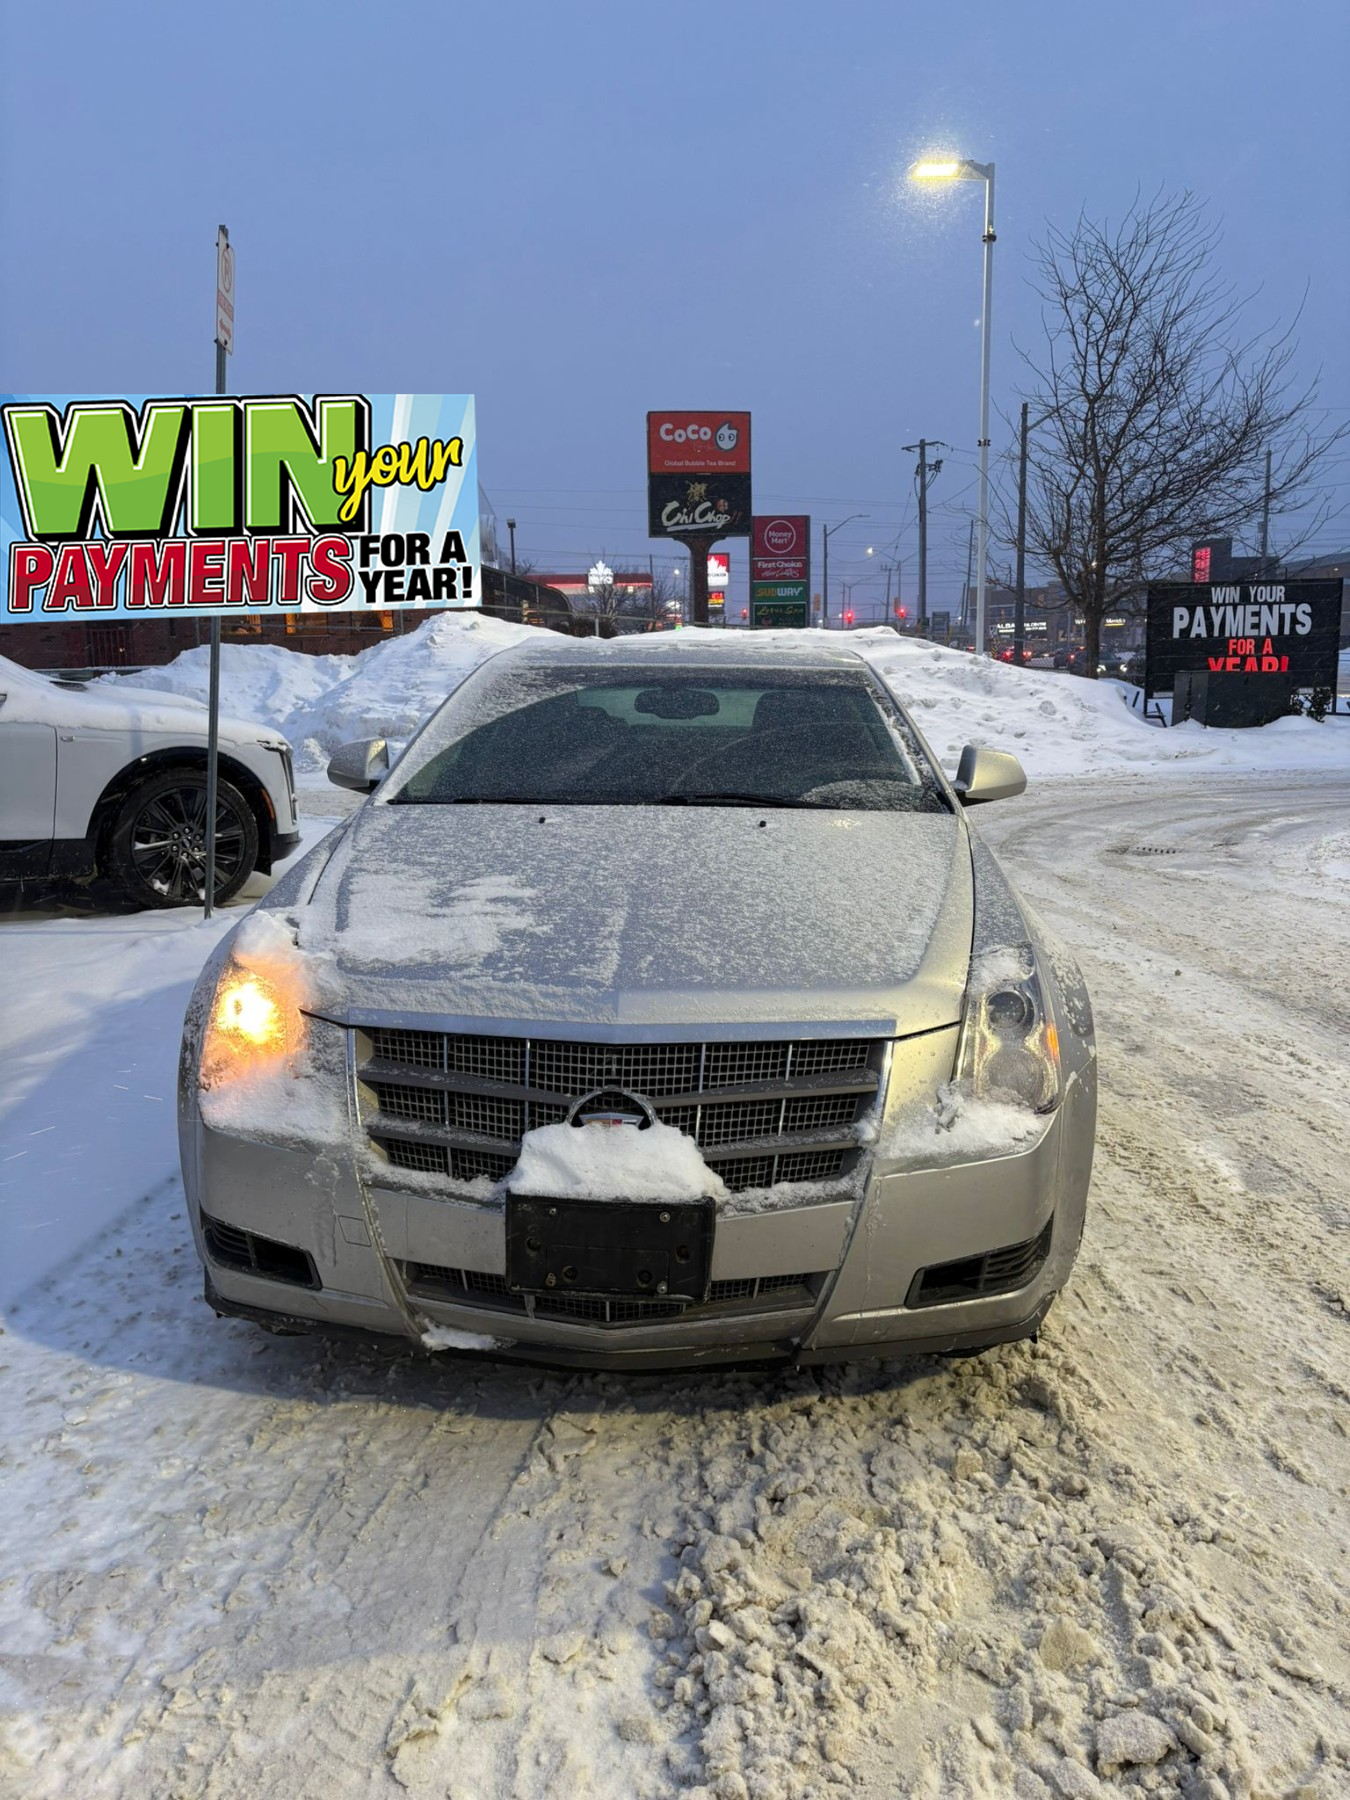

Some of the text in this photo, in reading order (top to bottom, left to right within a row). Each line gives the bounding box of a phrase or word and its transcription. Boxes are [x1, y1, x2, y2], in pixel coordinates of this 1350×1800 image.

[659, 423, 712, 443] CoCo
[768, 530, 793, 539] Money
[776, 560, 803, 568] Choice
[756, 586, 804, 597] SUBWAY
[1211, 586, 1286, 604] WIN YOUR
[1172, 603, 1312, 639] PAYMENTS
[1228, 637, 1273, 656] FOR A
